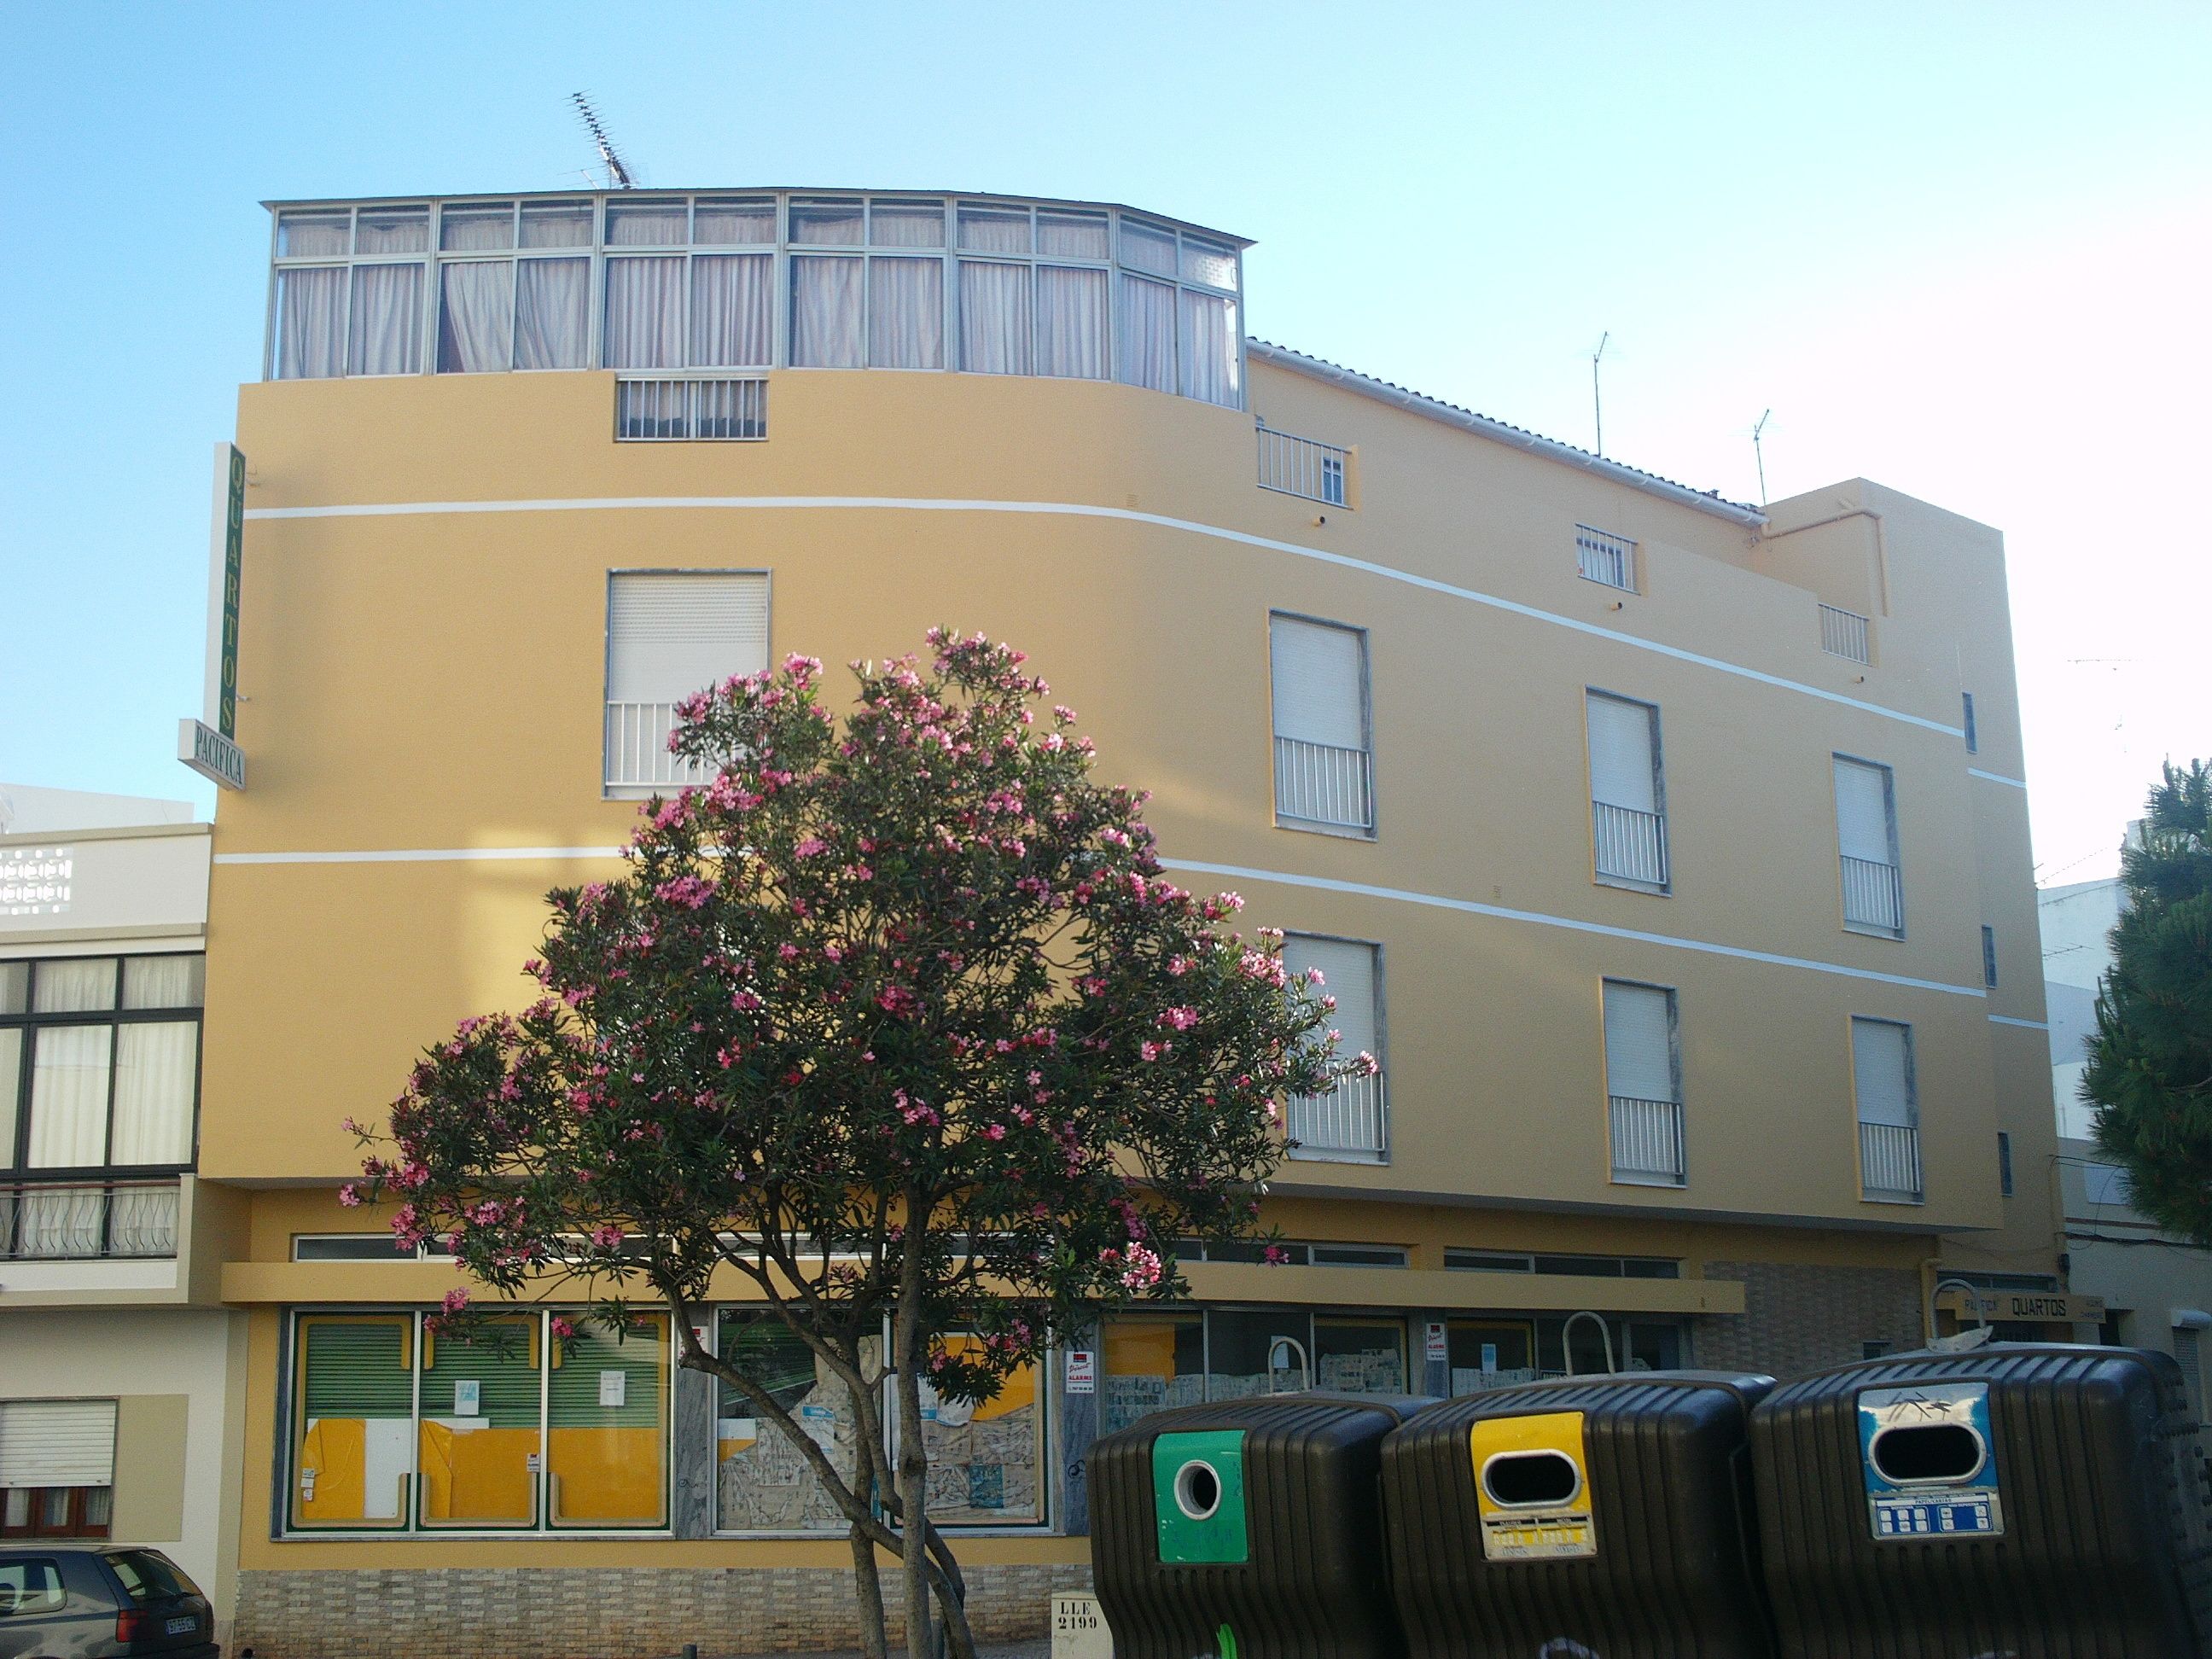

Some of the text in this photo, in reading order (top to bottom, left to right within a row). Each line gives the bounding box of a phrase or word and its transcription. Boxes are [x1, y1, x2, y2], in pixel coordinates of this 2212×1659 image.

[222, 457, 244, 730] QUARTOS
[195, 725, 242, 784] PACIFICA
[2011, 1297, 2066, 1317] QUARTOS
[1060, 1602, 1091, 1615] LLE
[1058, 1616, 1097, 1629] 2199
